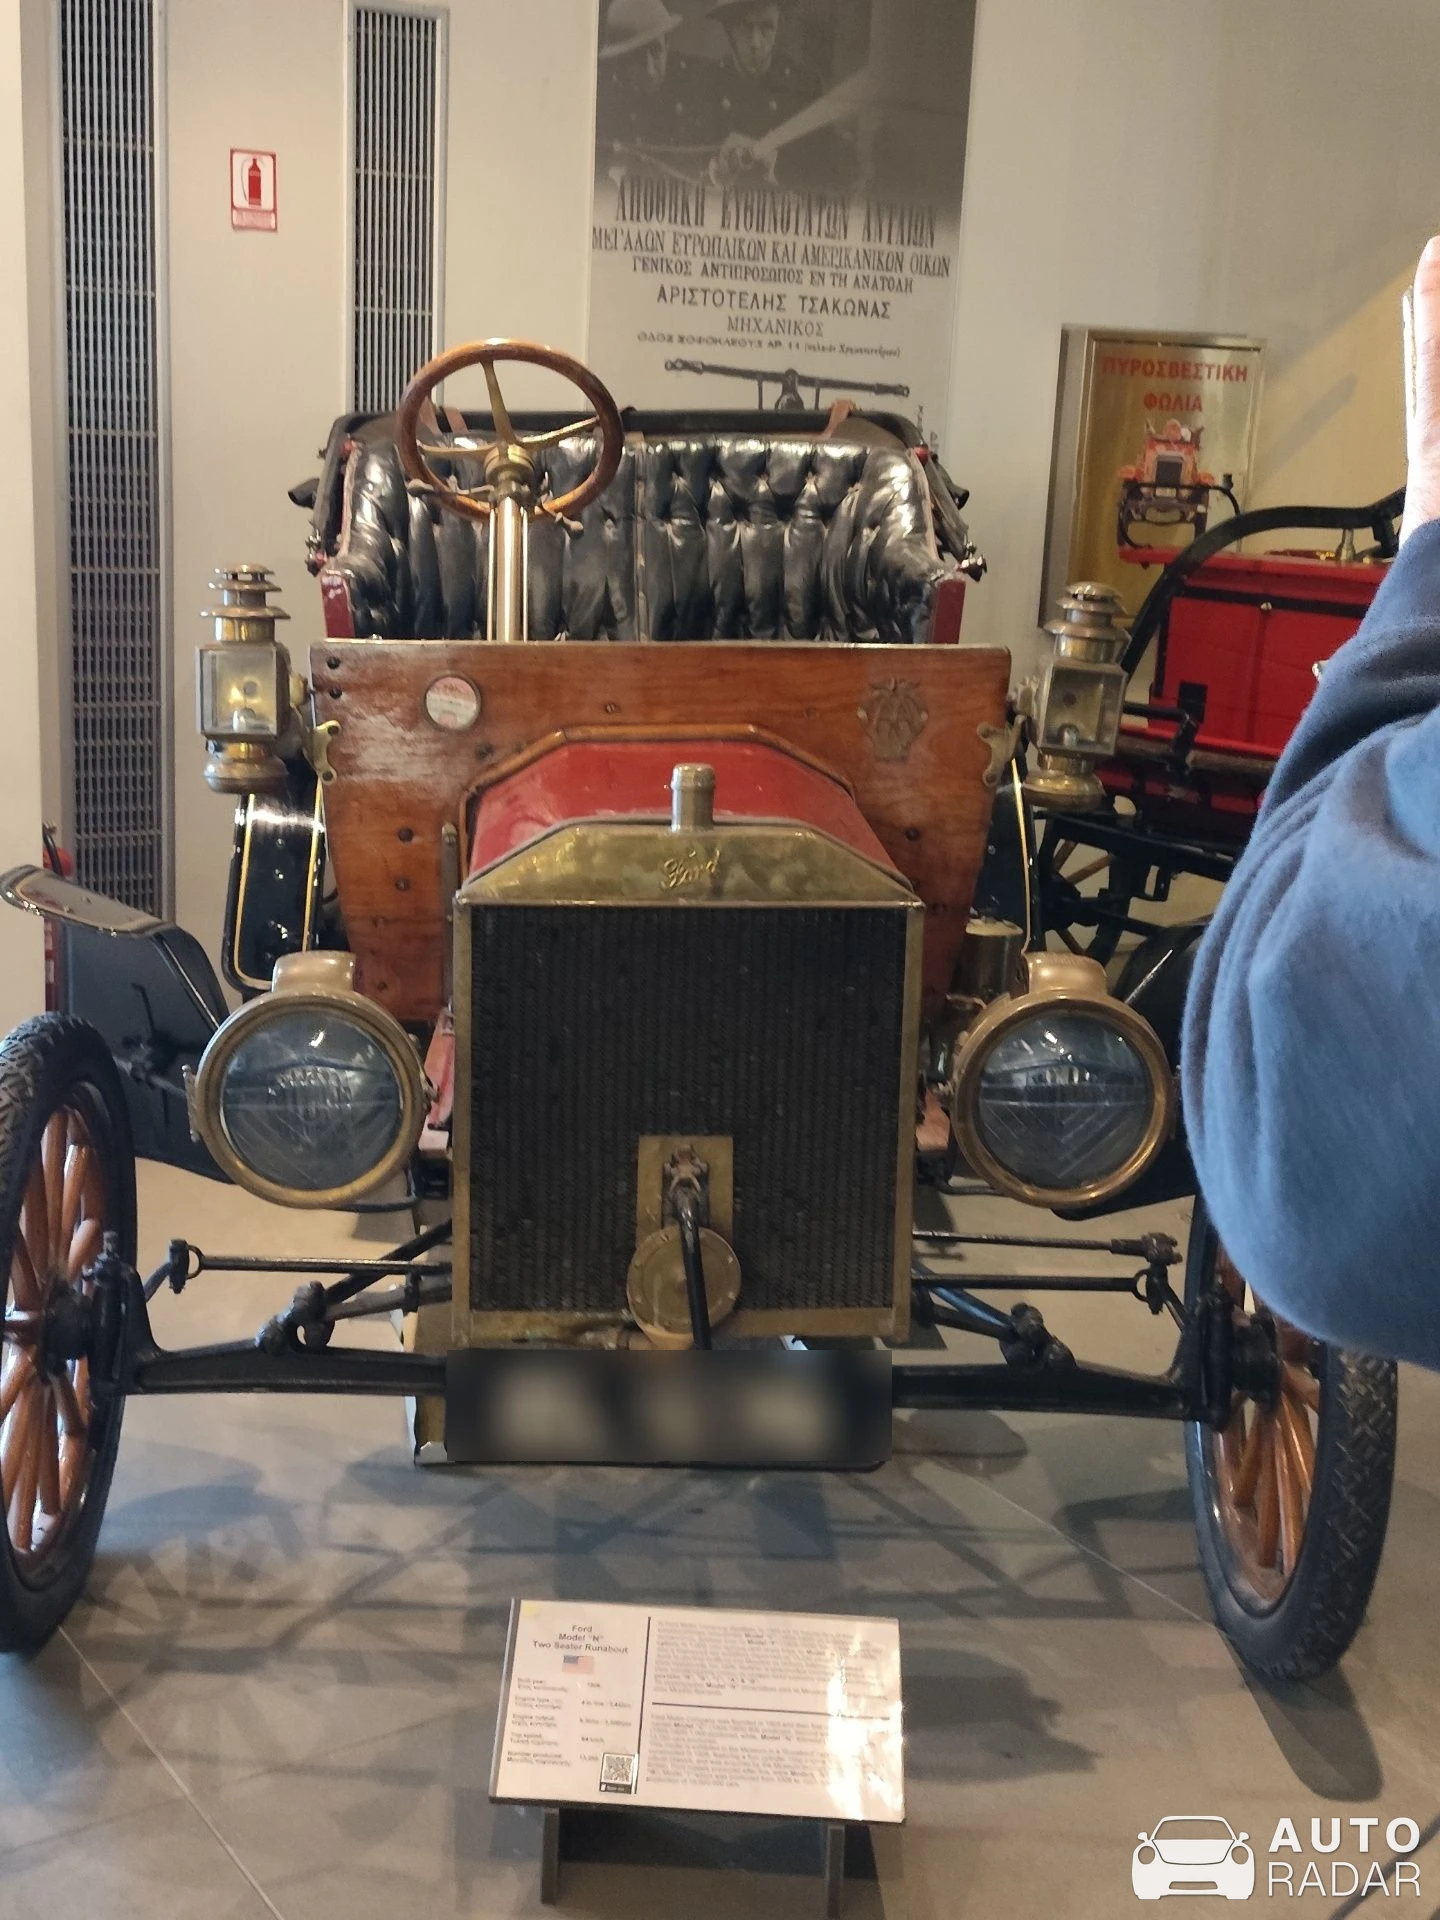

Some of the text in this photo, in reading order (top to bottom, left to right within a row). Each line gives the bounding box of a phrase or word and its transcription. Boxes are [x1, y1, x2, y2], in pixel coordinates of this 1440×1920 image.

[592, 226, 665, 253] ΜΕΓΑΛΩΝ
[772, 241, 796, 264] ΚΑΙ
[910, 252, 951, 278] ΟΙΚΩΝ
[632, 256, 913, 294] ΓΕΝΙΚΟΣ ΑΝΤΙΠΡΟΣΩΠΟΣ ΕΝ ΤΗ ΑΝΑΤΟΛΗ
[657, 284, 891, 319] ΑΡΙΣΤΟΤΕΛΗΣ ΤΣΑΚΩΝΑΣ
[727, 316, 824, 337] ΜΗΧΑΝΙΚΟΣ
[1102, 356, 1249, 383] ΠΥΡΟΣΒΕΣΤΙΚΗ
[1143, 393, 1203, 412] ΦΩΛΙΑ
[558, 1633, 585, 1641] Model
[572, 1625, 593, 1633] Ford
[533, 1640, 551, 1649] Two
[584, 1643, 629, 1654] Runabout
